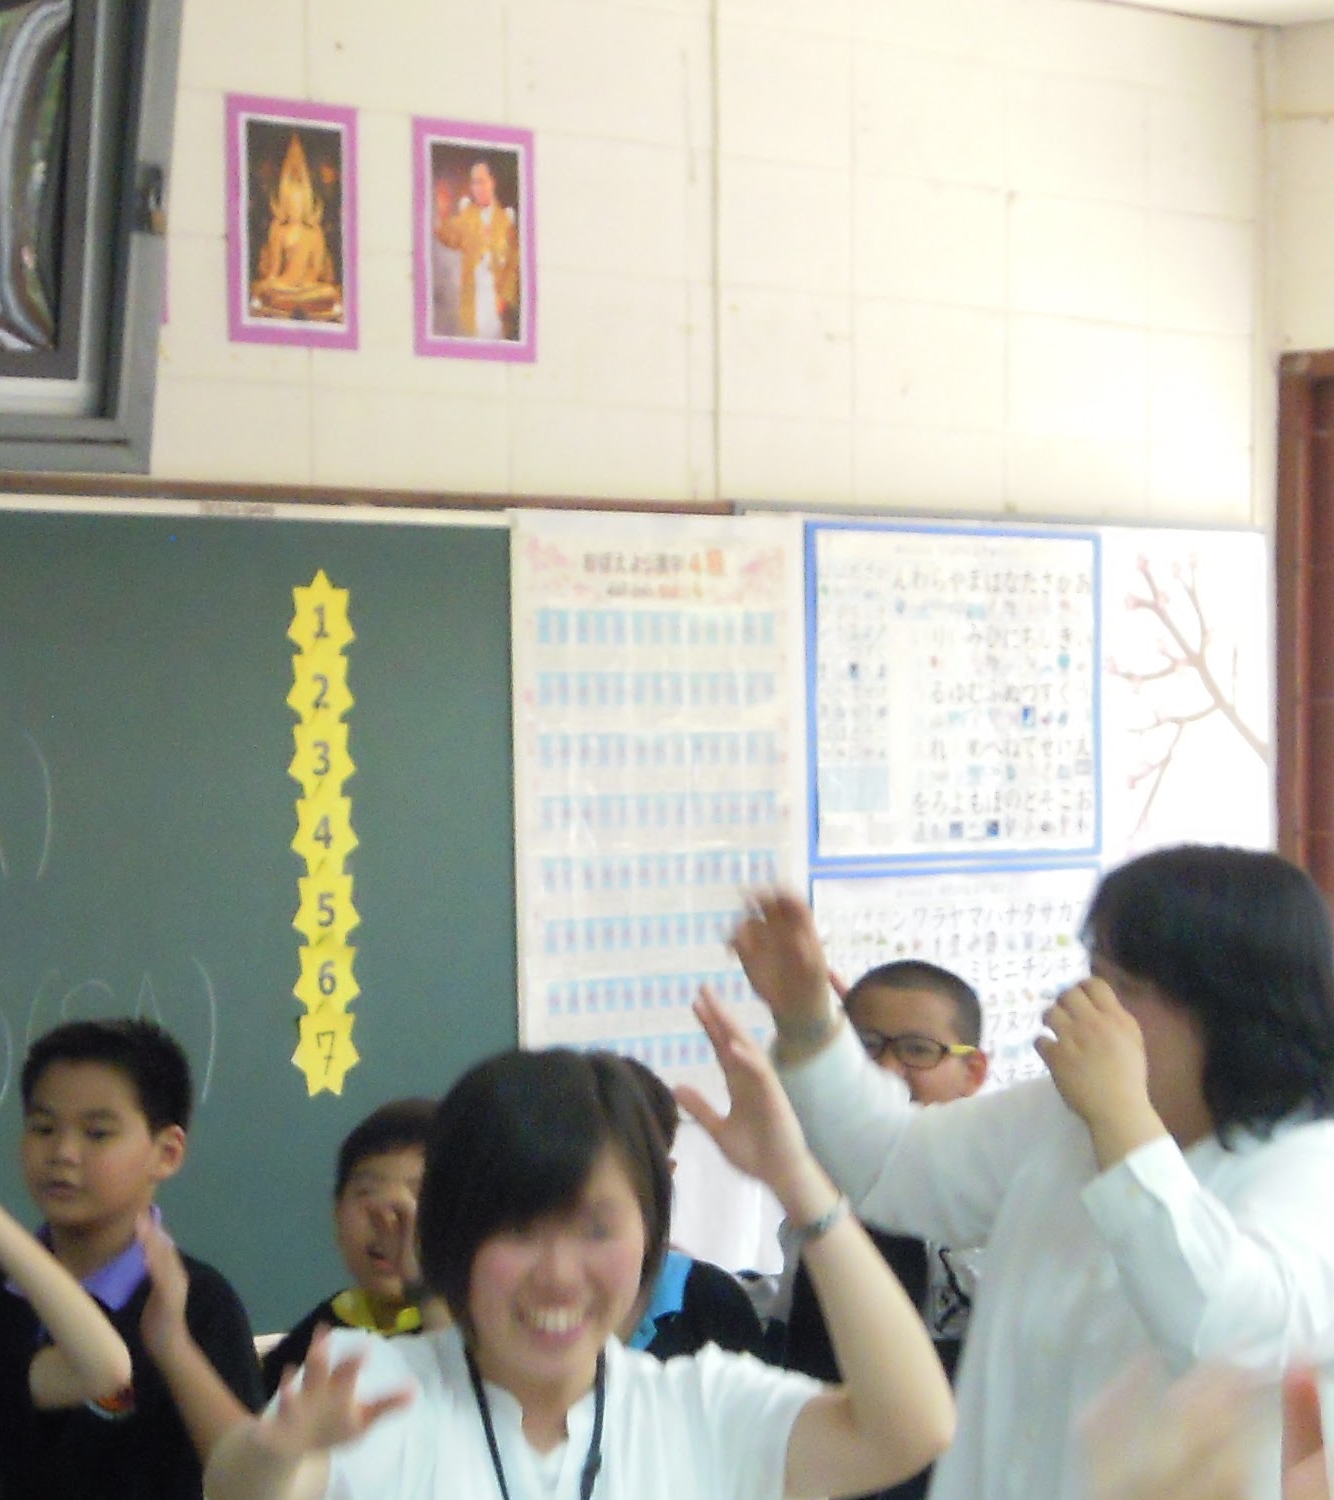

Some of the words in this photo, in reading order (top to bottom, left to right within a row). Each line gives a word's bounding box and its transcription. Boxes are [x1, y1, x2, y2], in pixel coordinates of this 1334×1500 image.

[313, 604, 329, 638] 1
[312, 674, 329, 709] 2
[312, 741, 331, 777] 3
[313, 814, 333, 850] 4
[317, 893, 335, 928] 5
[318, 961, 336, 996] 6
[315, 1030, 338, 1076] 7
